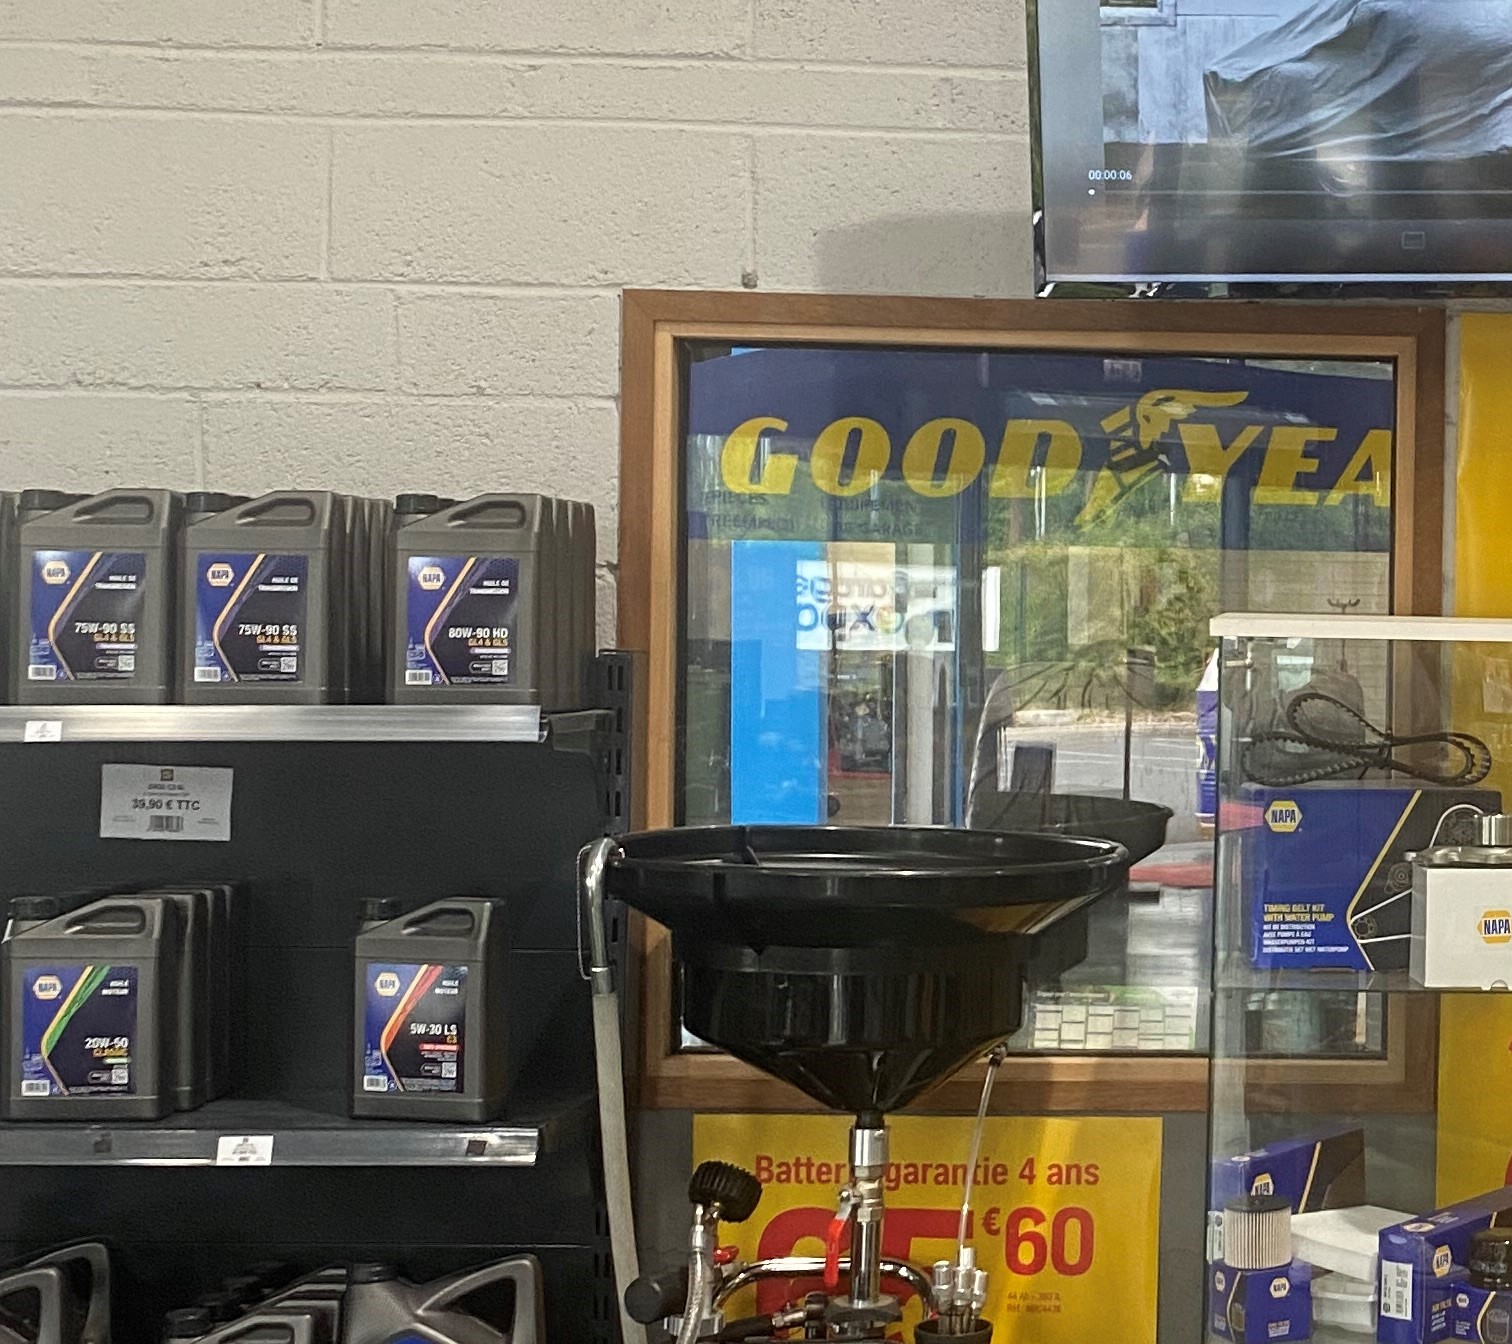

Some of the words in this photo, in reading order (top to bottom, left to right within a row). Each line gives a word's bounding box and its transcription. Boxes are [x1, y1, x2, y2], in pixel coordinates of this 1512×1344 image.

[1088, 170, 1133, 181] 00:00:06
[721, 417, 1083, 498] GOOD
[1178, 423, 1393, 507] YEA
[177, 800, 201, 811] TTC
[1270, 809, 1297, 824] NAPA
[1483, 919, 1511, 935] NAPA
[755, 1155, 852, 1186] Batter
[887, 1156, 1008, 1192] garantie
[1018, 1157, 1036, 1185] 4
[1046, 1163, 1100, 1186] ans
[1005, 1206, 1095, 1278] 60
